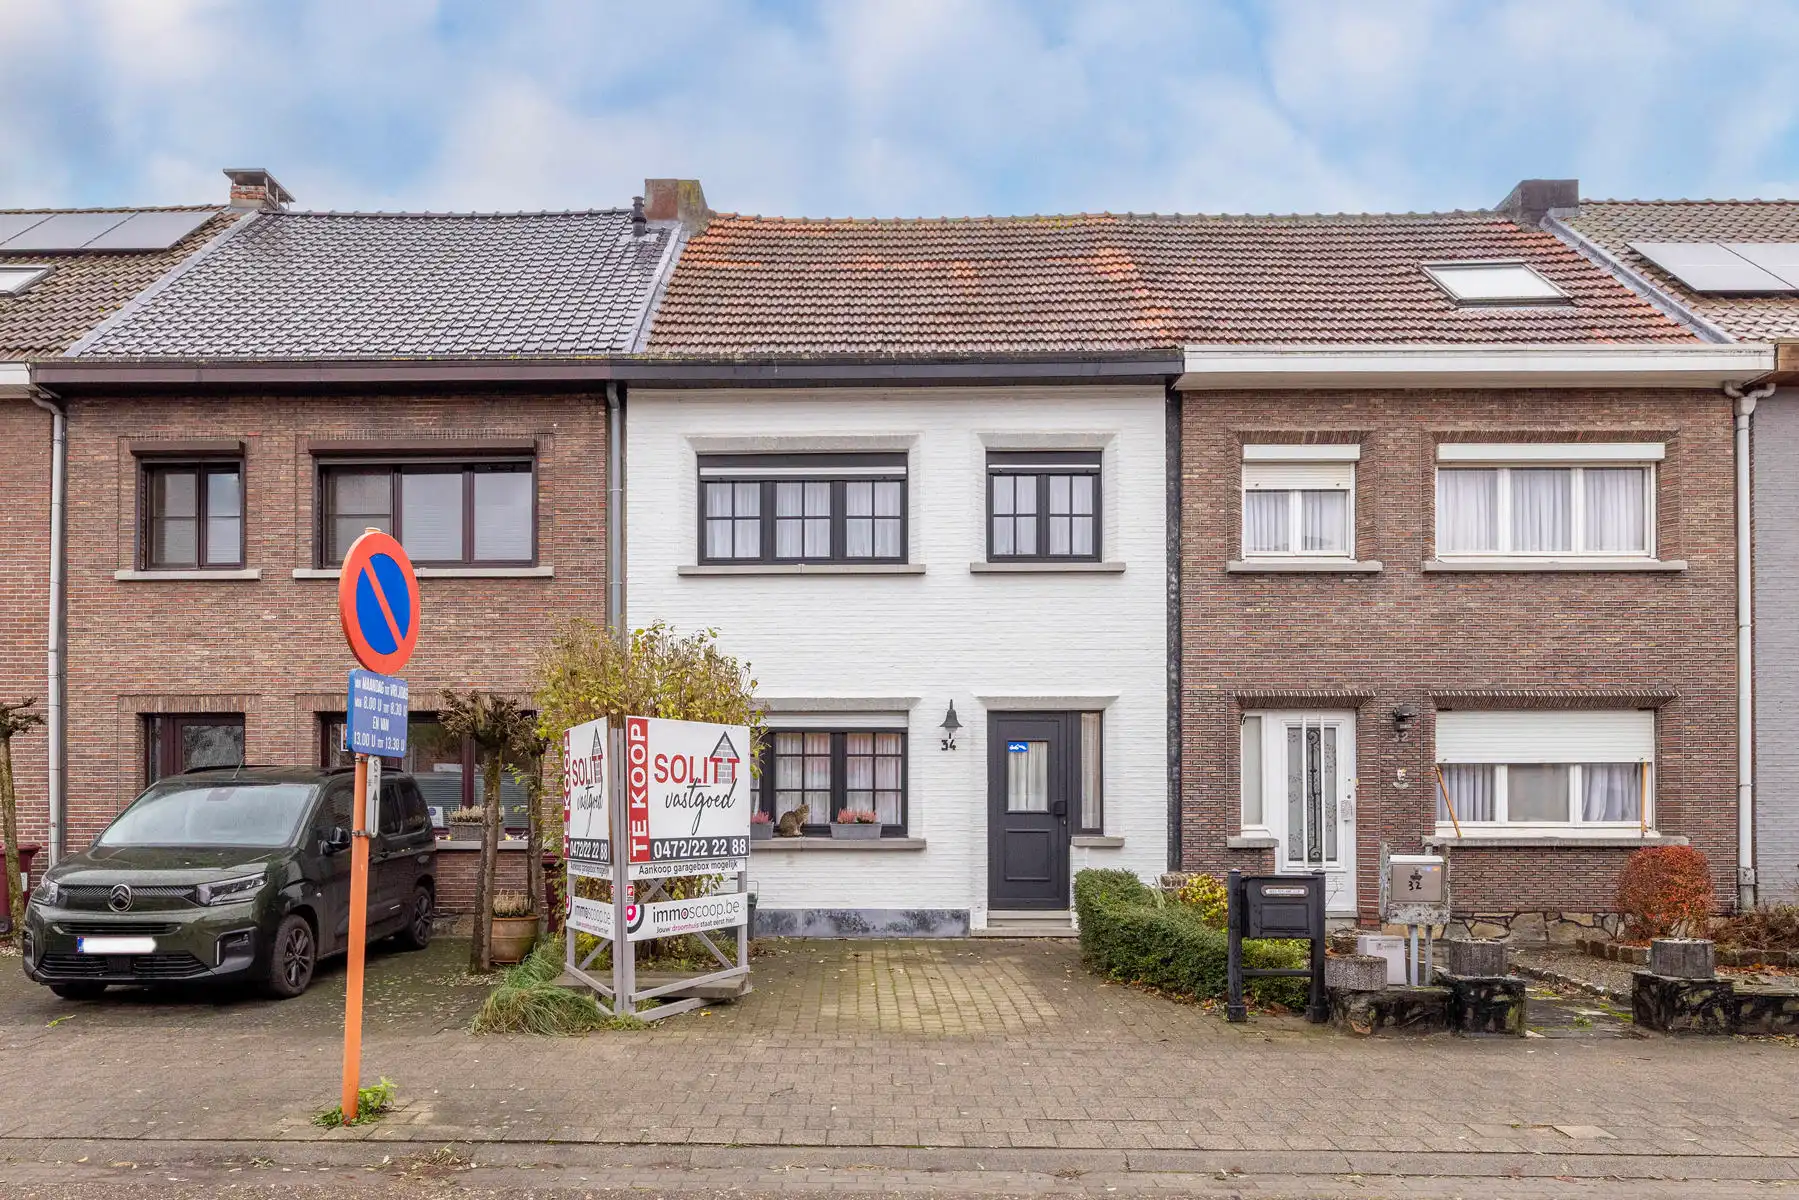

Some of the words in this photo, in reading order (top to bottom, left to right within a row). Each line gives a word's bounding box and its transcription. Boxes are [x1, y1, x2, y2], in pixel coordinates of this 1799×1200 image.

[363, 696, 376, 711] 8.00
[377, 698, 382, 712] U
[372, 716, 380, 729] EN
[354, 731, 370, 747] 13.00
[371, 734, 376, 748] U
[400, 739, 405, 752] U
[941, 739, 956, 751] 34
[572, 753, 603, 787] SOLITT
[630, 723, 647, 809] KOOP
[654, 753, 740, 784] SOLITT
[665, 777, 737, 836] vastgoed
[632, 819, 648, 857] TE
[653, 838, 708, 858] 0472/22
[712, 839, 728, 855] 22
[732, 838, 746, 855] 88
[591, 842, 600, 860] 22
[638, 864, 671, 875] Aankoop
[673, 861, 709, 874] garagebox
[711, 859, 738, 871] mogelijk
[1408, 880, 1422, 891] 32
[653, 900, 740, 923] immoscoop.be
[671, 922, 699, 932] droomhuis
